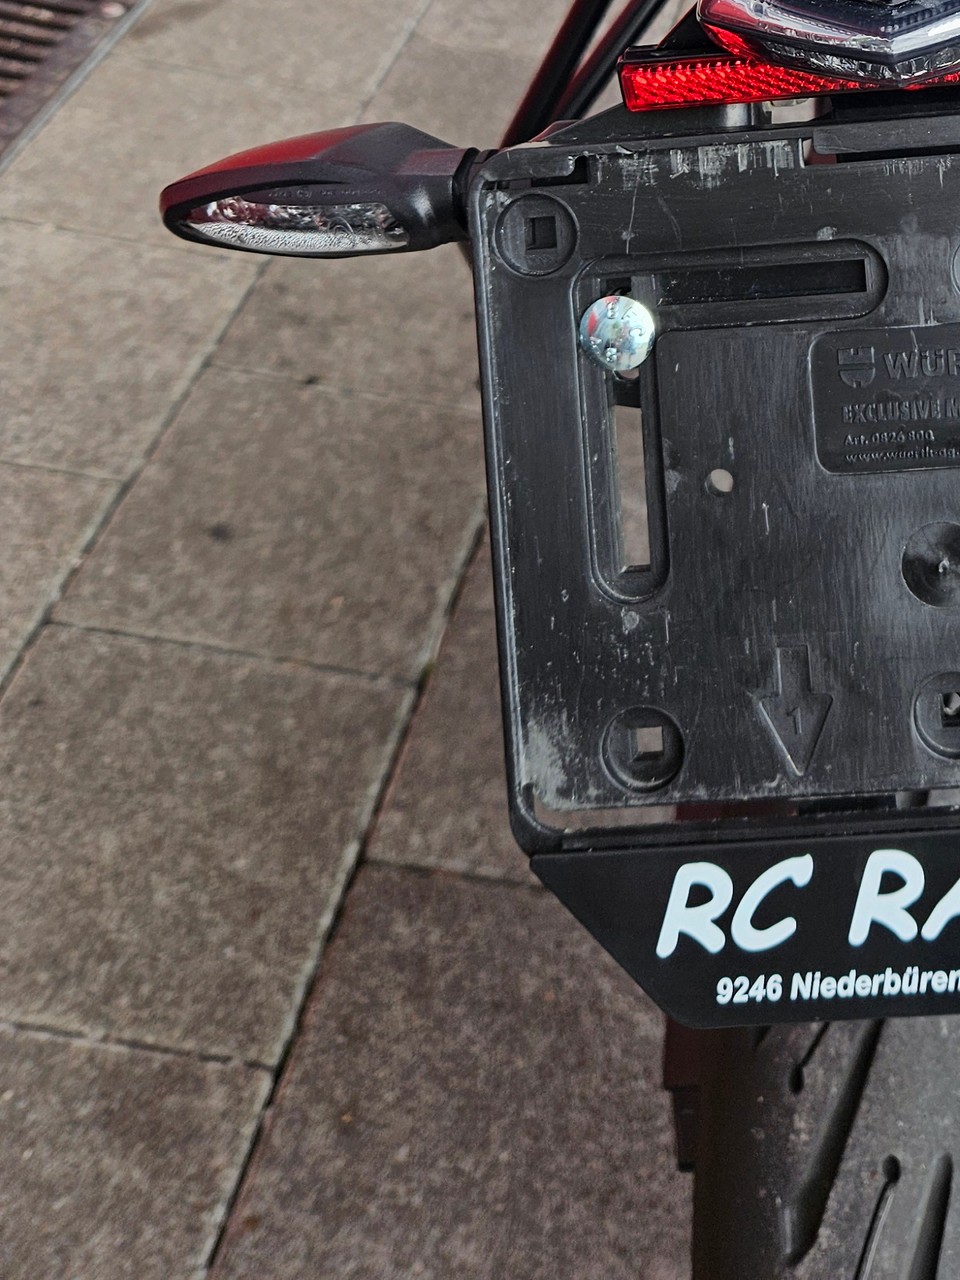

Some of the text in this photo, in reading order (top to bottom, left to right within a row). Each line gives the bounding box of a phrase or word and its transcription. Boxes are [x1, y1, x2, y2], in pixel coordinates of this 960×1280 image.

[842, 399, 941, 423] EXCLUSIVE
[786, 705, 802, 736] 1
[656, 853, 814, 959] RC
[716, 974, 783, 1006] 9246
